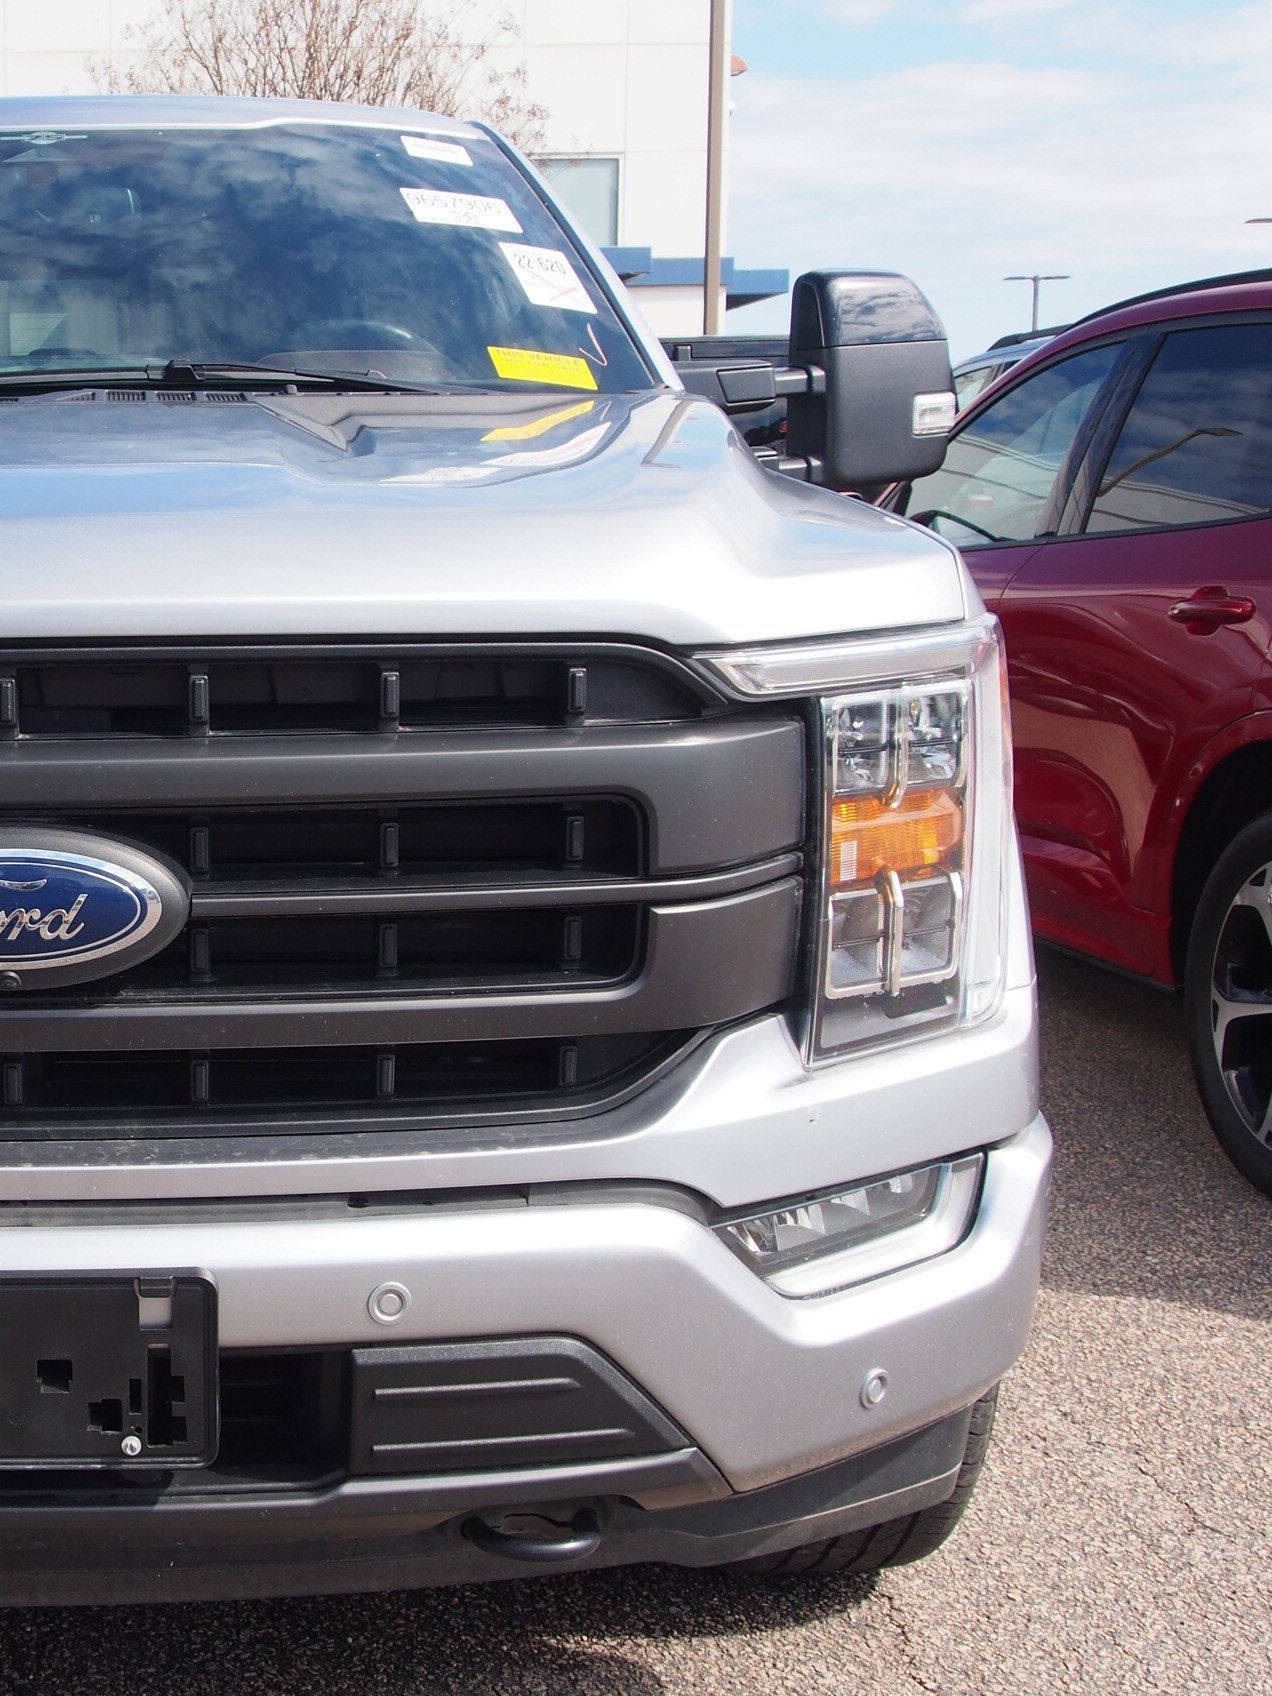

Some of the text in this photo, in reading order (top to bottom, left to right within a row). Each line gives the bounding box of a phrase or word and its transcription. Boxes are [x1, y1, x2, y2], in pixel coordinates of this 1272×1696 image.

[496, 349, 582, 367] THIS VEHICLE
[500, 357, 582, 373] NOT FOR SALE
